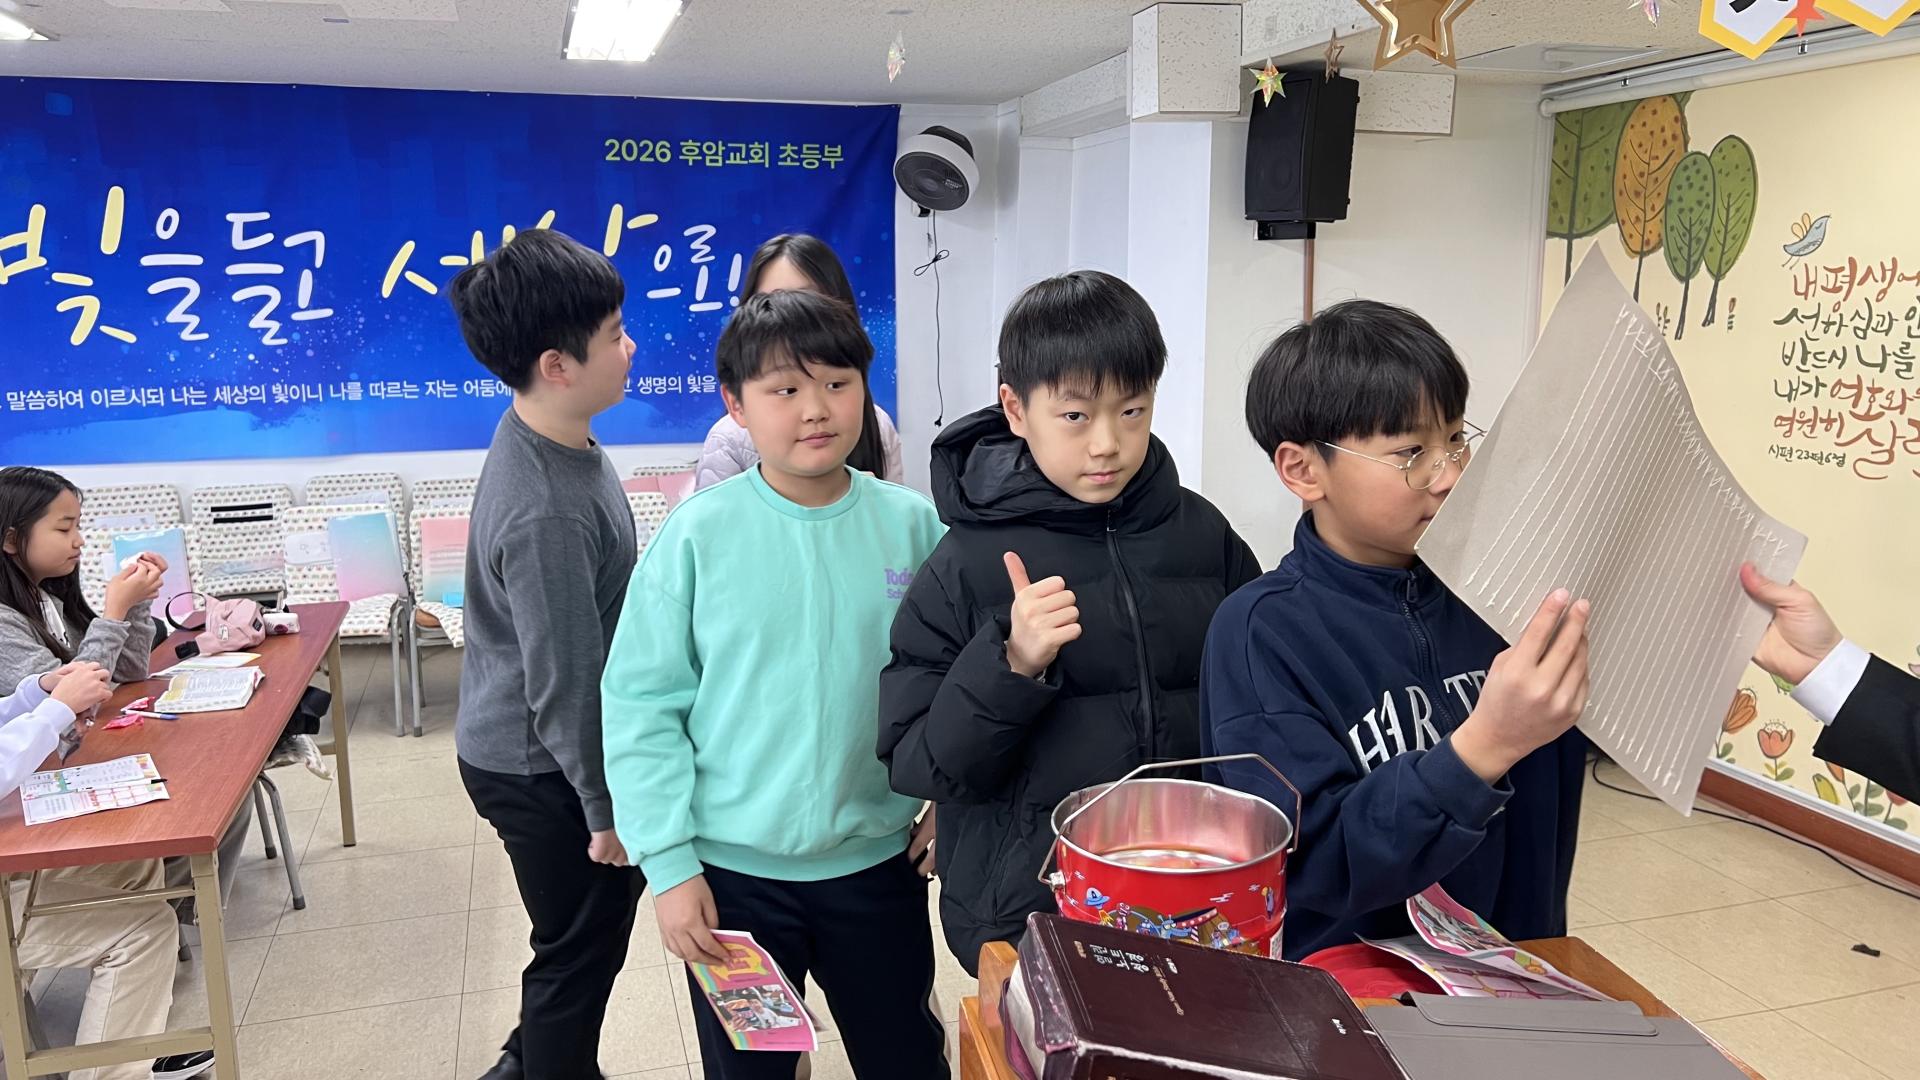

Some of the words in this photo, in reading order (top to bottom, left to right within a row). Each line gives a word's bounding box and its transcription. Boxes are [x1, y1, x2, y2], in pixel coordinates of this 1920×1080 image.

[604, 139, 672, 163] 2026
[679, 139, 769, 168] 후암교회
[777, 143, 844, 169] 초등부
[1781, 337, 1848, 373] 반드시
[1856, 341, 1916, 380] 나를
[6, 388, 84, 411] 말씀하여
[90, 386, 165, 408] 이르시되
[171, 385, 208, 405] 나는
[213, 384, 266, 405] 세상의
[272, 381, 323, 404] 빛이니
[330, 381, 364, 401] 나를
[369, 379, 420, 400] 따르는
[425, 379, 458, 399] 자는
[463, 379, 512, 398] 어둠에
[637, 375, 682, 395] 생명의
[687, 374, 717, 393] 빛을
[1774, 406, 1846, 439] 영원히
[1768, 444, 1793, 463] 시편
[1110, 949, 1130, 971] 노트
[1125, 952, 1150, 973] 성경
